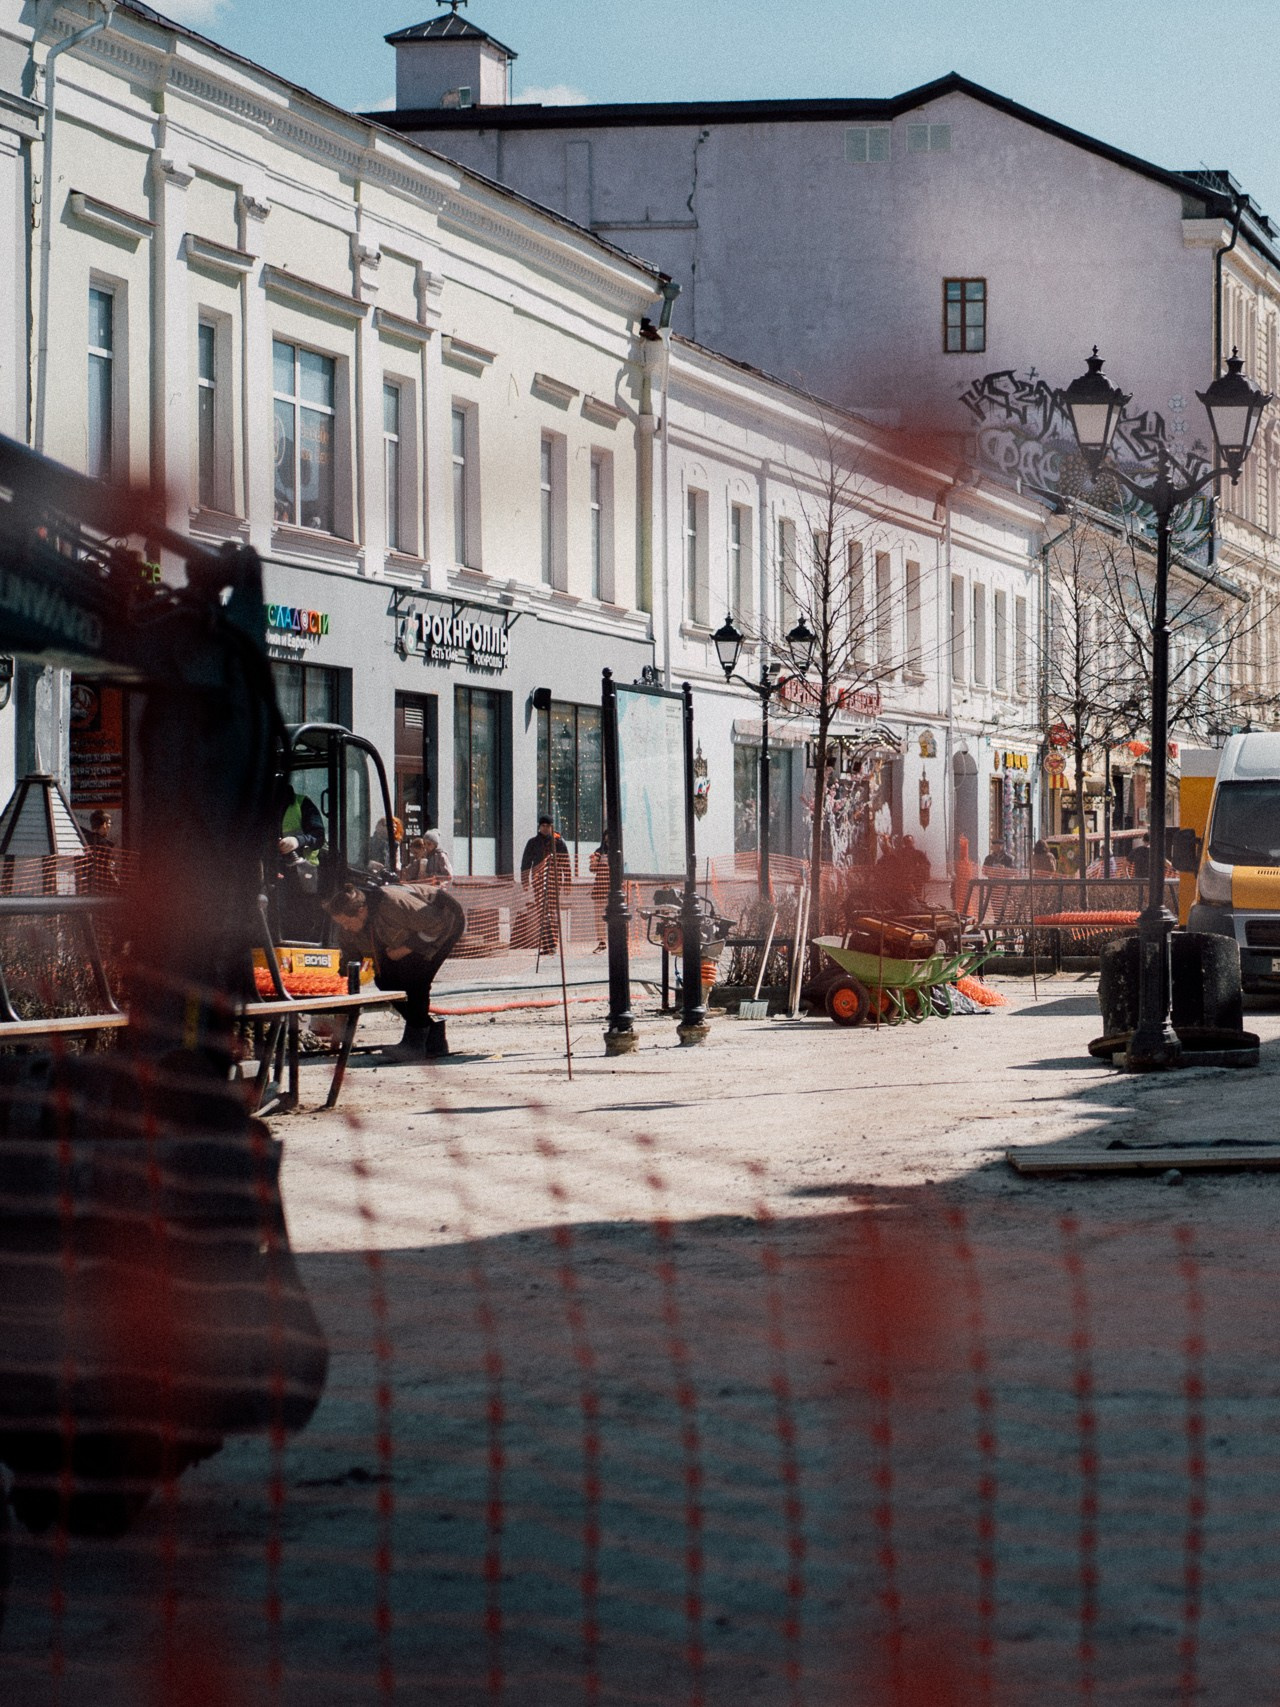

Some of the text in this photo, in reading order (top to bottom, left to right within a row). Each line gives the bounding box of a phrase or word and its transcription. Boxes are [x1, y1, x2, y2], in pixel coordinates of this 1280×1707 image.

[267, 604, 329, 635] СЛАДОСТИ
[422, 613, 510, 655] РОКНРОЛЛЫ
[304, 955, 328, 965] 8016
